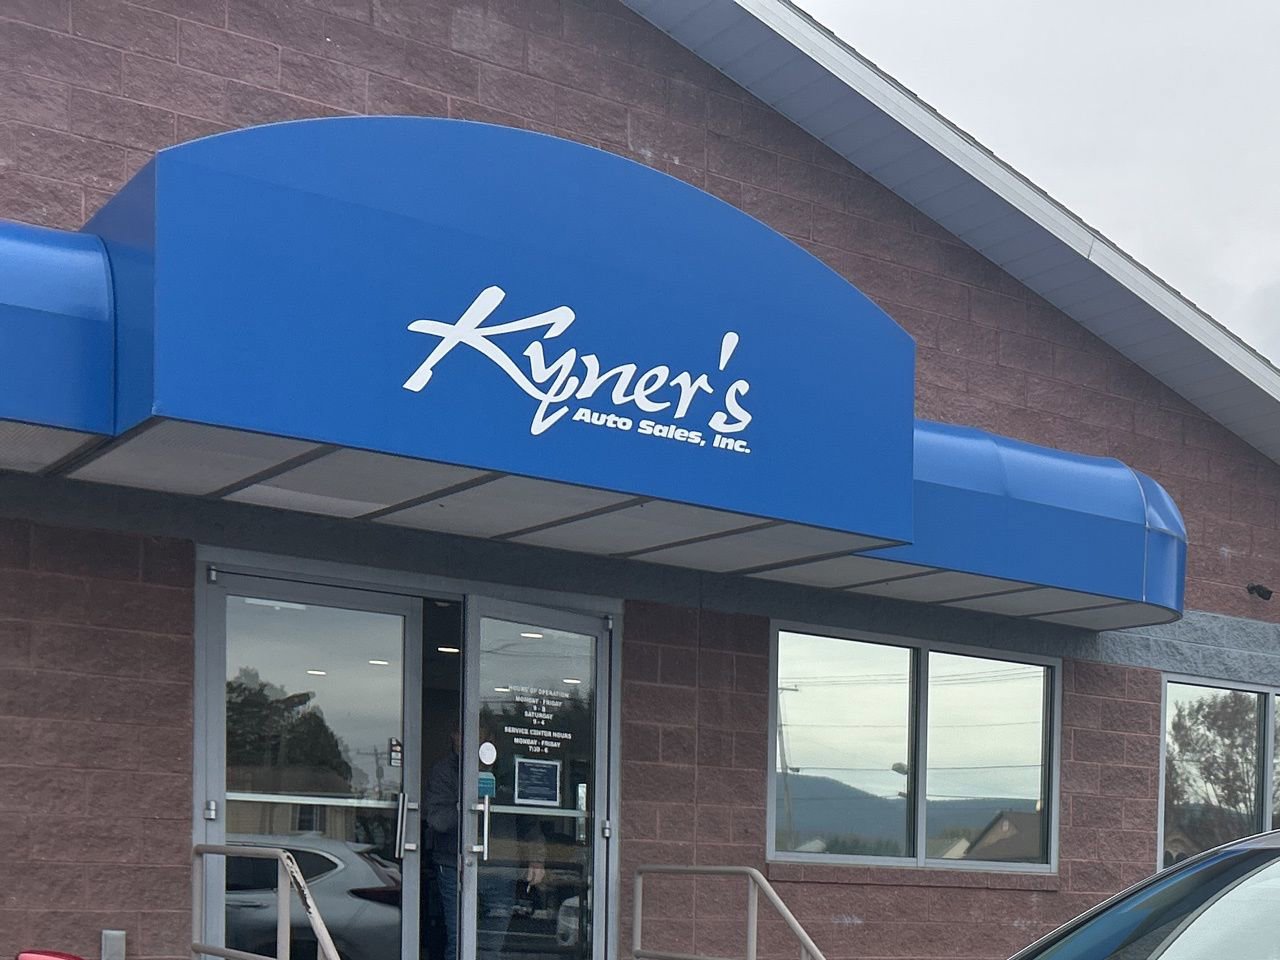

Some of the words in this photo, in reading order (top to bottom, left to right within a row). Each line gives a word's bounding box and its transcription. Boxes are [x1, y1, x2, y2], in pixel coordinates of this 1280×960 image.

[403, 285, 752, 436] Kyner's
[572, 408, 632, 431] Auto
[637, 420, 706, 447] Sales,
[712, 434, 751, 454] Inc.
[515, 695, 539, 704] MONDAY
[542, 699, 563, 707] FRIDAY
[524, 710, 553, 720] SATURDAY
[504, 726, 529, 735] SERVICE
[529, 729, 551, 737] CENTER
[552, 731, 572, 740] HOURS
[514, 737, 538, 746] MONDAY
[541, 740, 560, 748] FRIDAY
